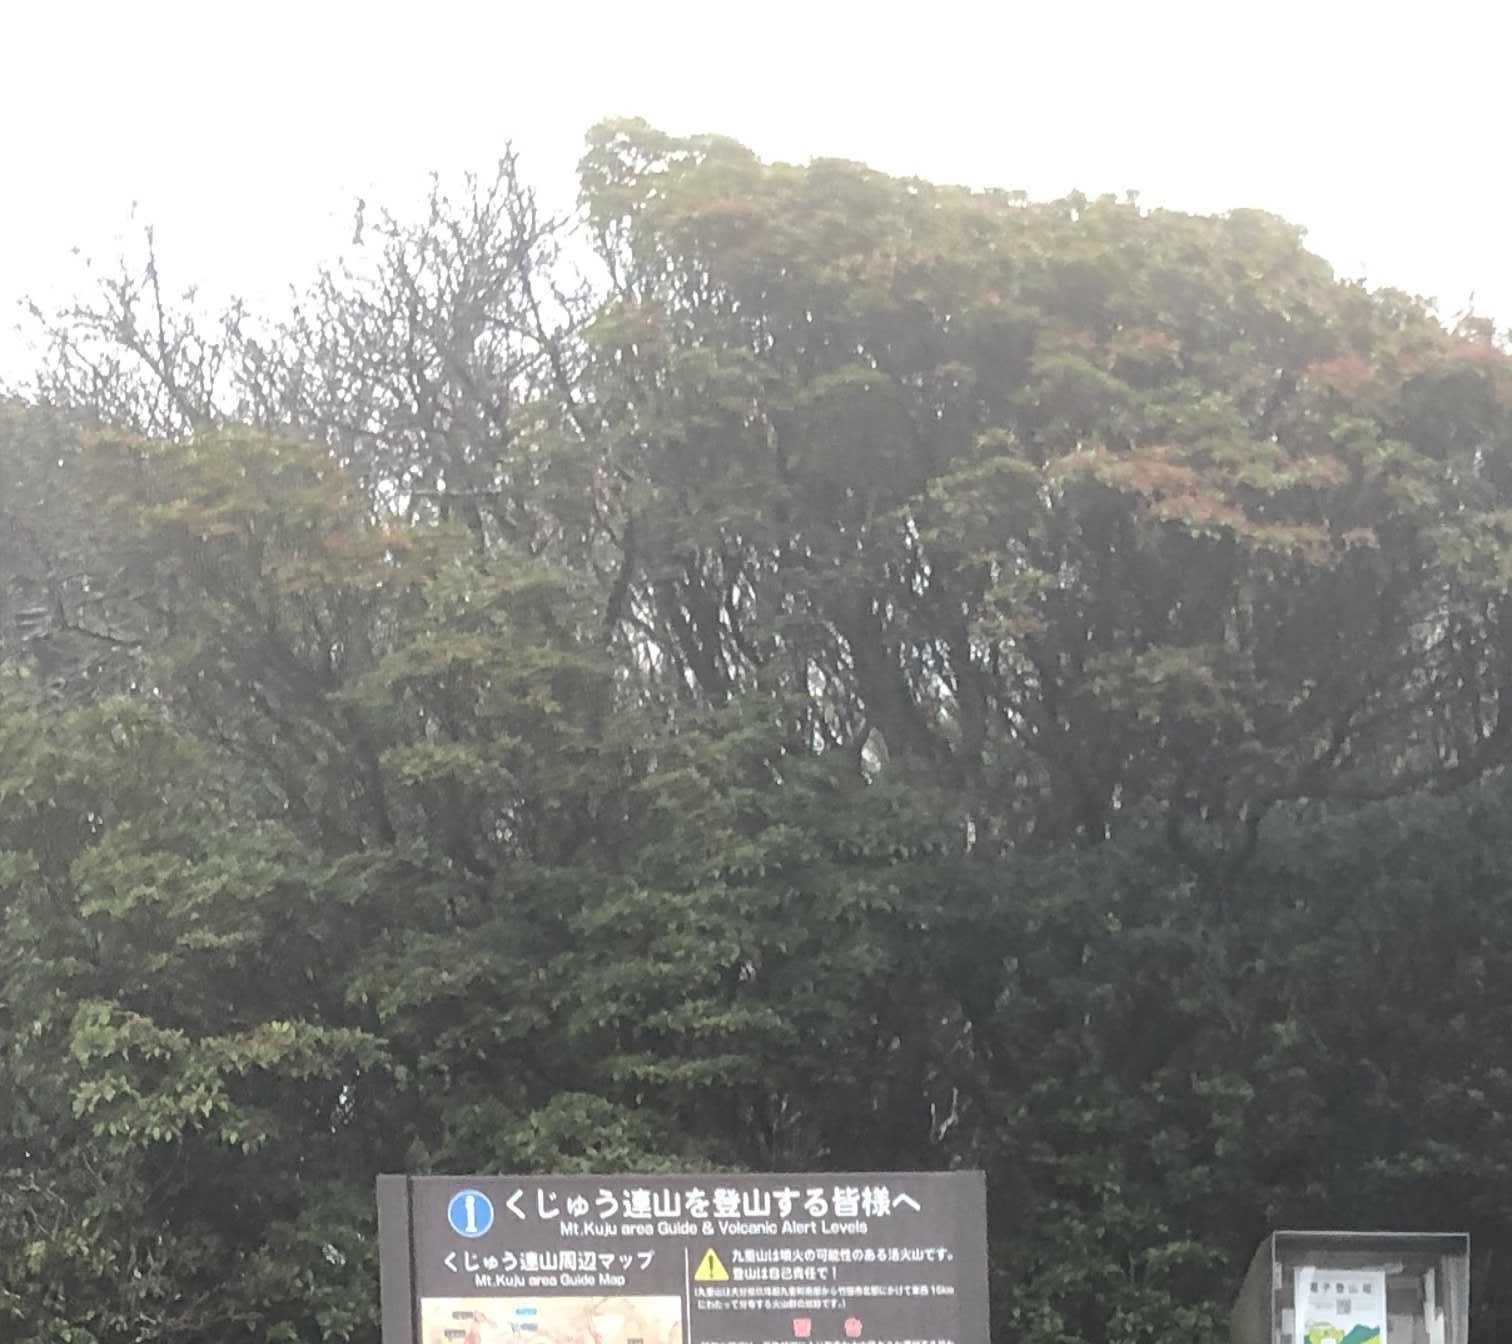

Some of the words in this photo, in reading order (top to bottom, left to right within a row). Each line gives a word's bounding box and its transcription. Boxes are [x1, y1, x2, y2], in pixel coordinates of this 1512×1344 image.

[506, 1186, 921, 1220] くじゅう連山を登山する皆様へ
[560, 1221, 617, 1237] Mt.Kuju
[621, 1225, 653, 1236] area
[658, 1221, 697, 1236] Guide
[702, 1221, 714, 1236] &
[719, 1220, 777, 1236] Volcanic
[782, 1220, 816, 1235] Alert
[822, 1220, 867, 1235] Levels
[444, 1250, 655, 1272] くじゅう連山周辺マップ
[475, 1273, 524, 1288] Mt.Kuju
[529, 1277, 557, 1287] area
[560, 1273, 595, 1287] Guide
[599, 1274, 625, 1288] Map
